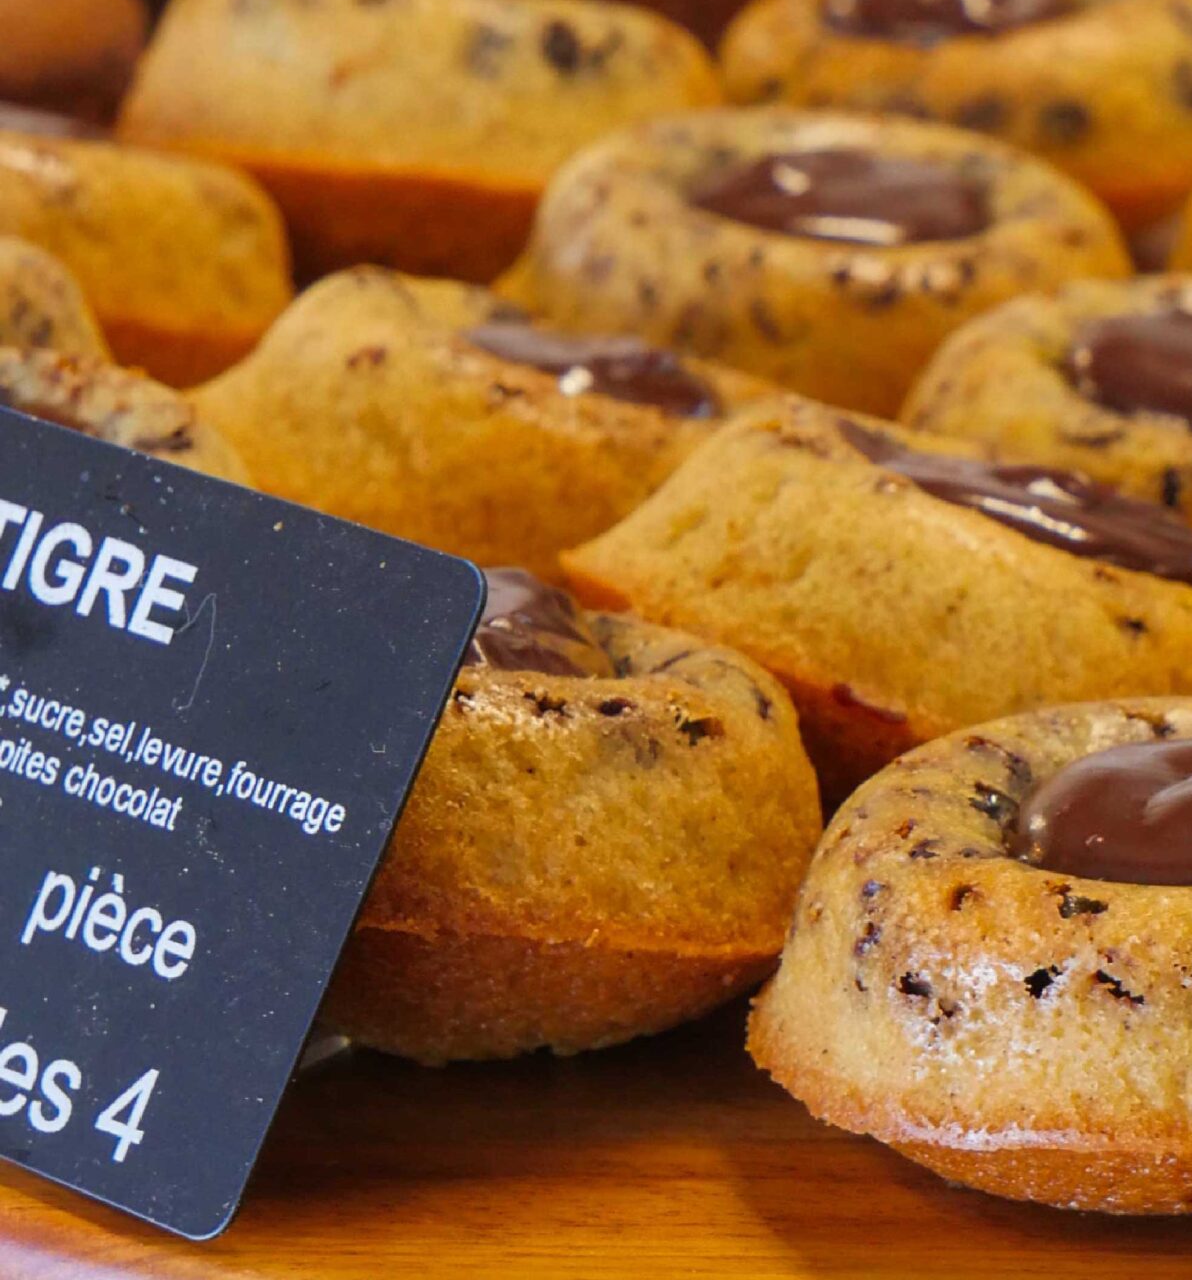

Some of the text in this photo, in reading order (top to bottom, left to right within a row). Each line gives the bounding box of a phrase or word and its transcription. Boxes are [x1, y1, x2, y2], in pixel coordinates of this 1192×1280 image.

[63, 763, 183, 831] chocolat
[21, 866, 196, 979] pièce
[0, 1006, 160, 1162] es 4
